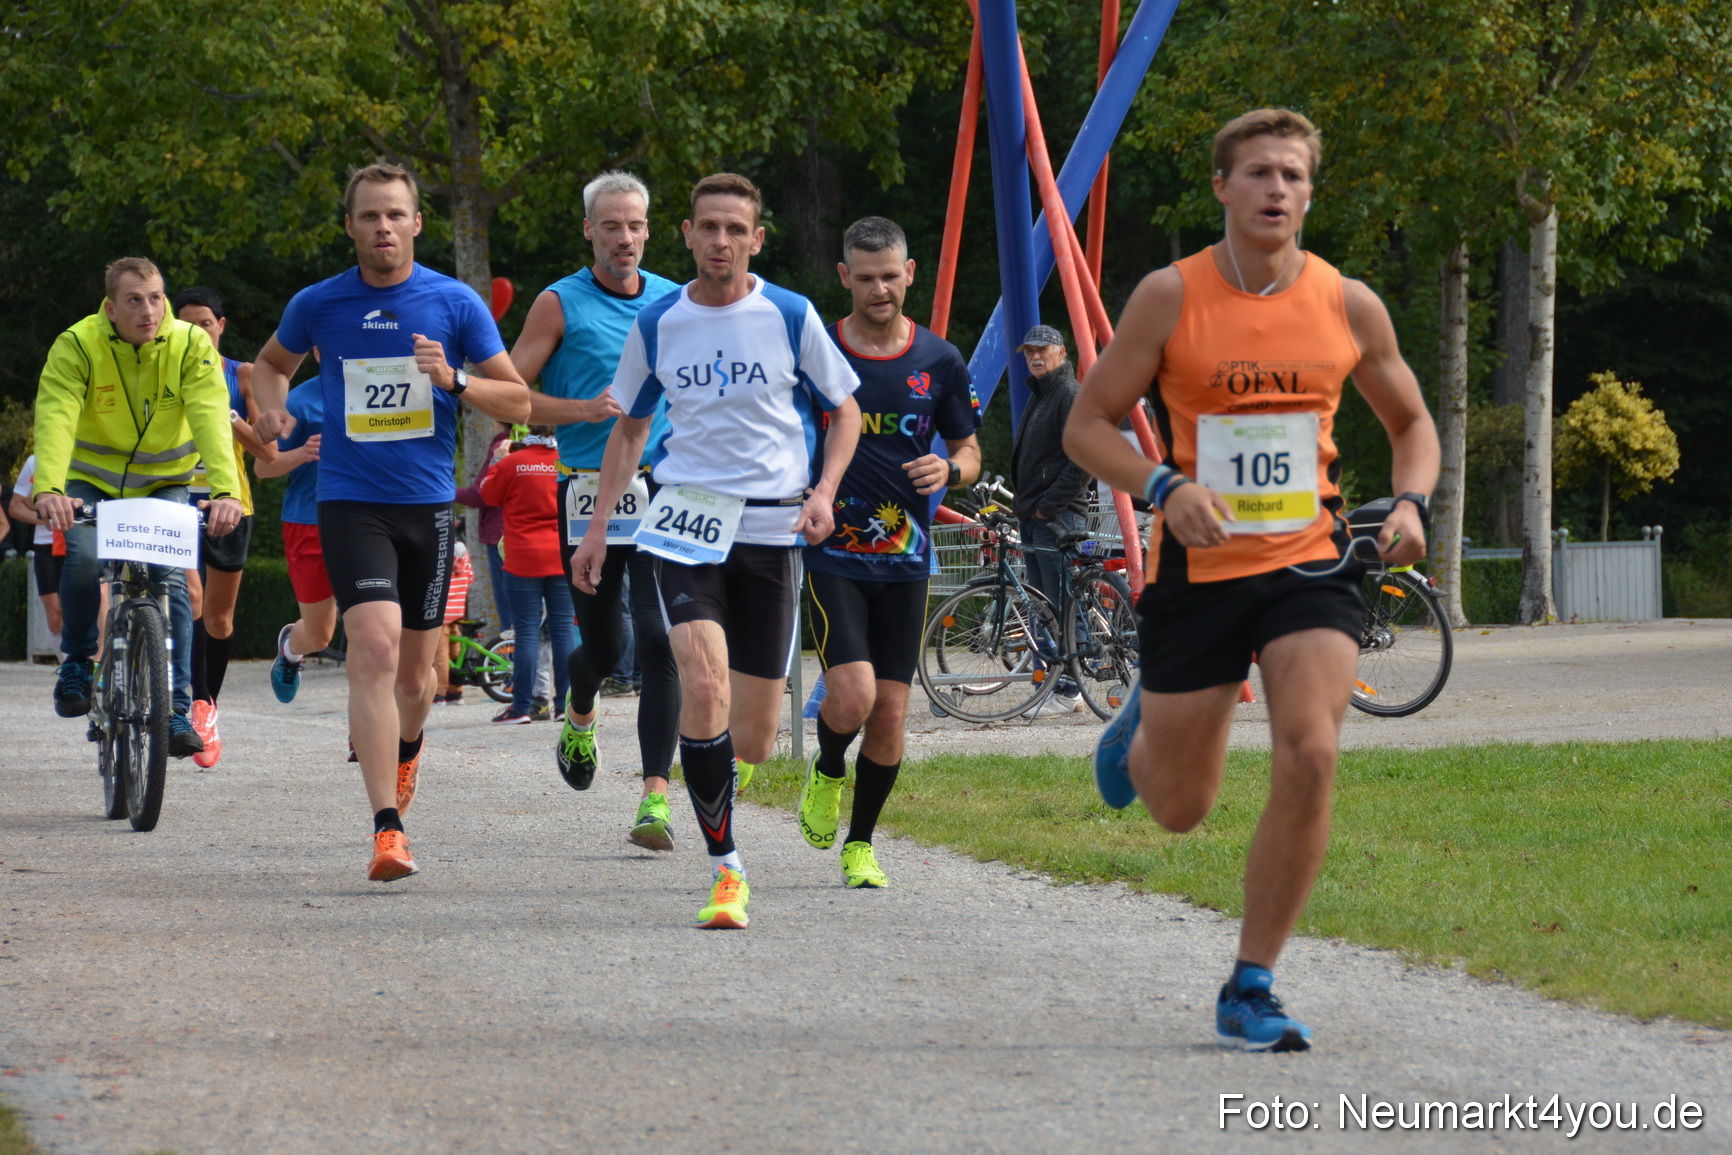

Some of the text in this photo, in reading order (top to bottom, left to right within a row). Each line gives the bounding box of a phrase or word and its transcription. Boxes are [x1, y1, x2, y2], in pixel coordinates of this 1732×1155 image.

[362, 321, 399, 330] skinfit
[676, 357, 769, 390] SUSPA
[1227, 371, 1307, 395] OEXL
[365, 382, 411, 409] 227
[368, 415, 412, 428] Christoph
[822, 411, 931, 437] NSCH
[1229, 451, 1291, 487] 105
[578, 493, 637, 516] 28
[1237, 499, 1284, 512] Richard
[117, 523, 181, 539] Erste Frau
[654, 505, 723, 544] 2446
[105, 538, 192, 557] Halbmarathon
[662, 539, 696, 555] Werner
